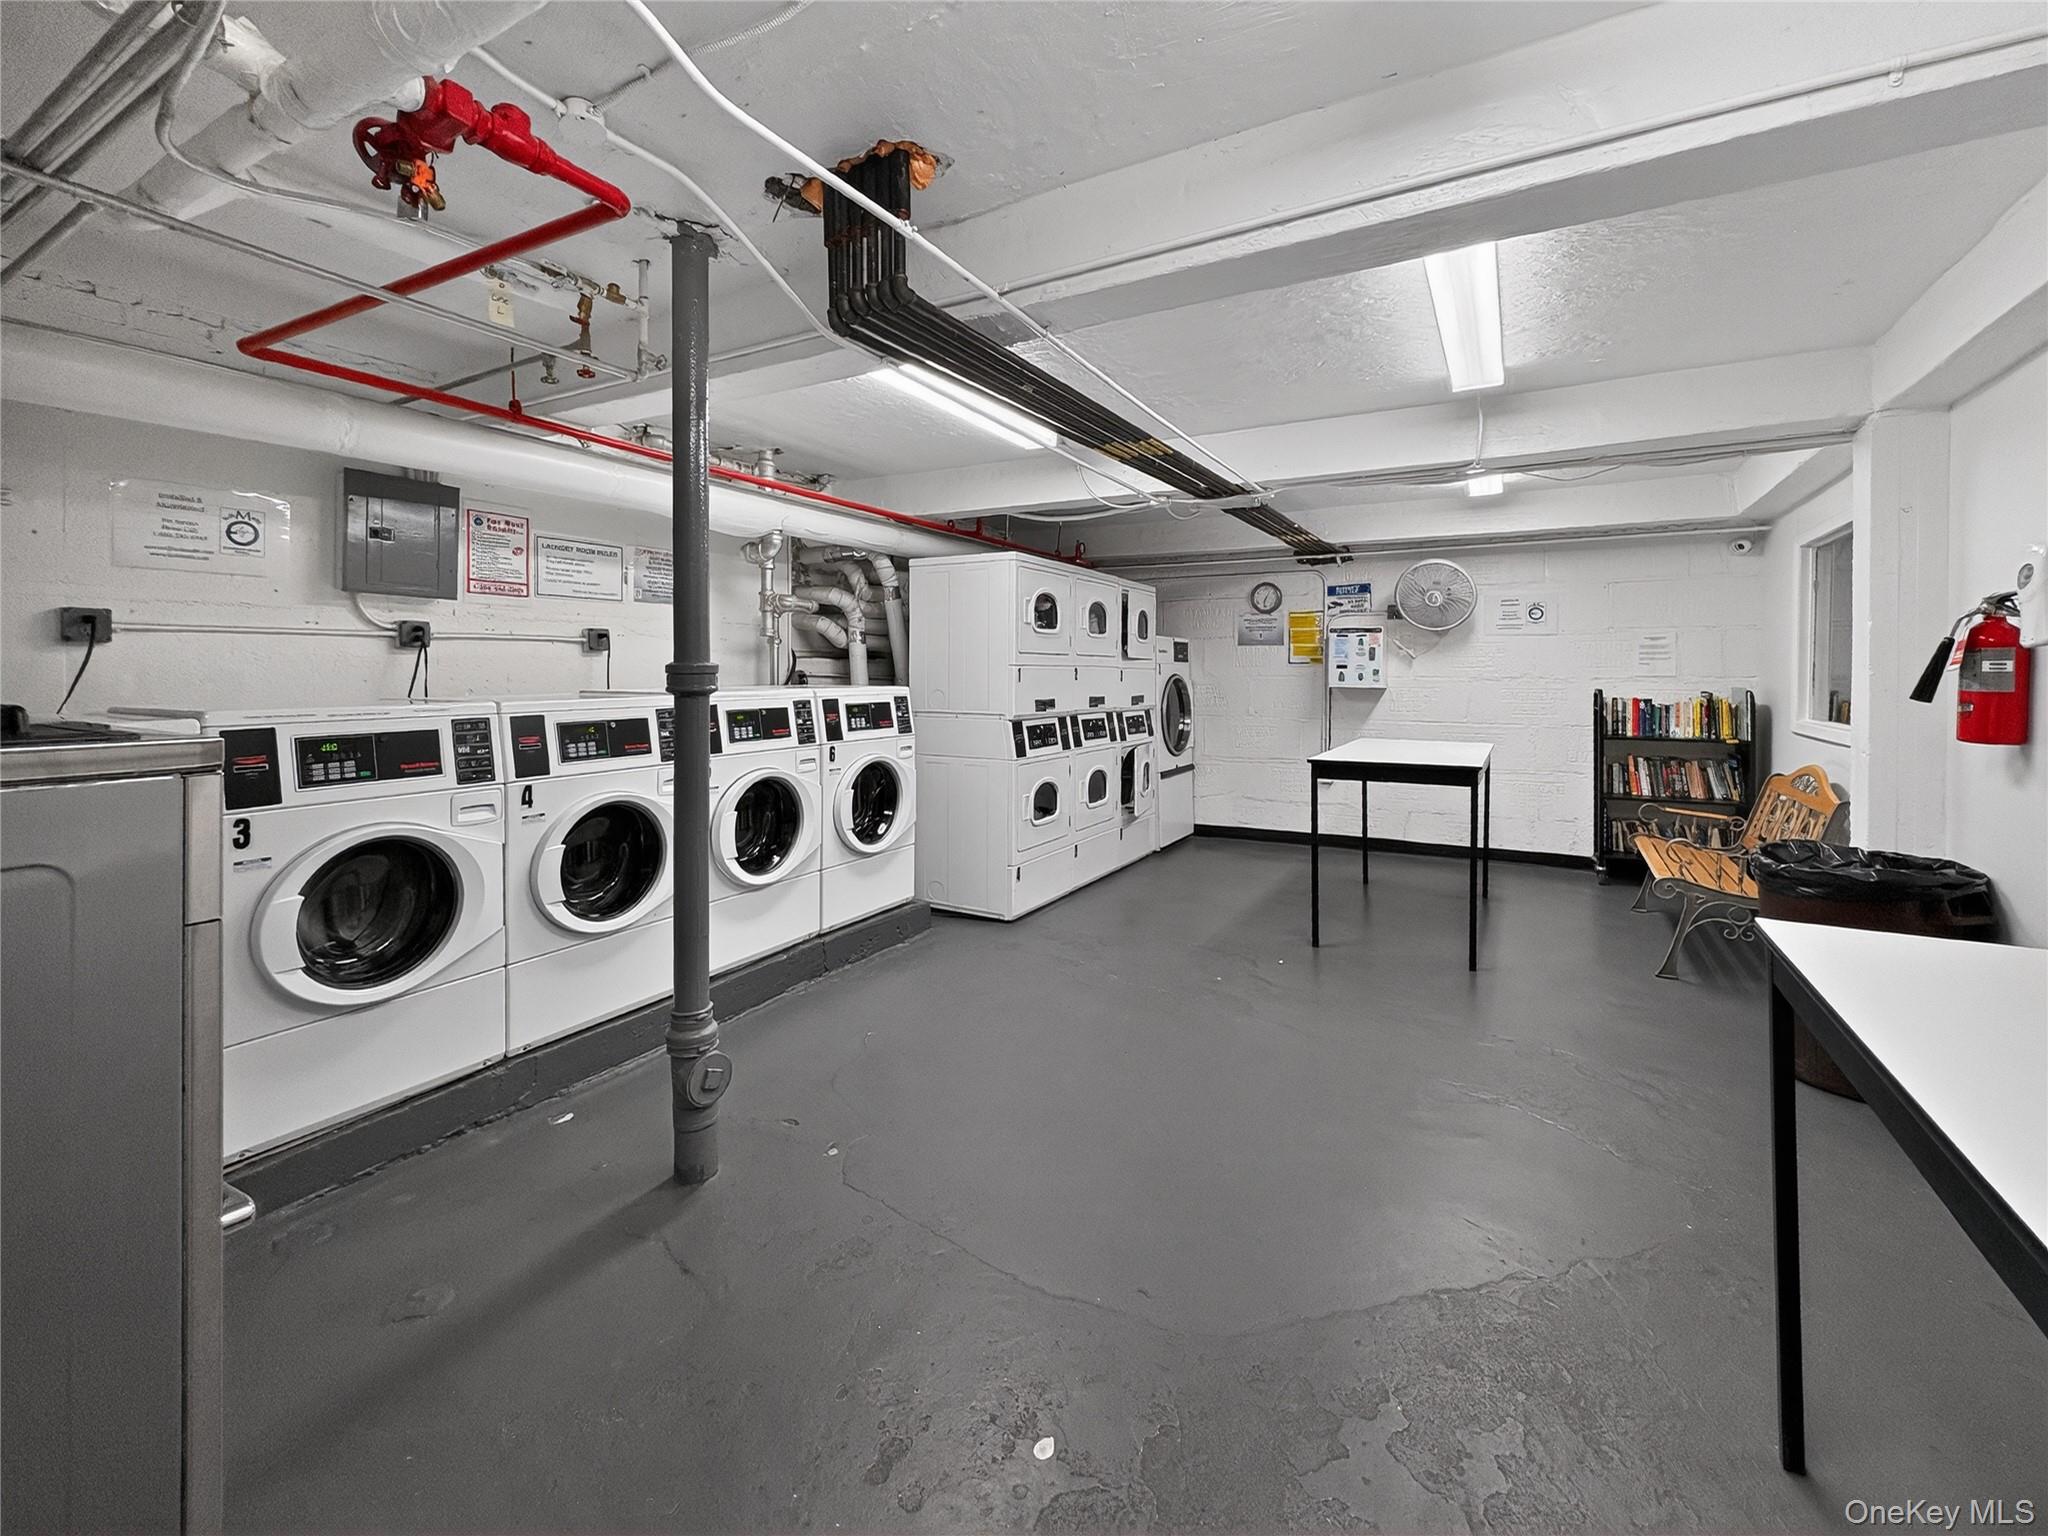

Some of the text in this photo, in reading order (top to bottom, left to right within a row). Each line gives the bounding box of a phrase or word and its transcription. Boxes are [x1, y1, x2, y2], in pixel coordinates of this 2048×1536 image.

[828, 745, 836, 763] 6
[521, 784, 534, 809] 4
[232, 818, 251, 849] 3
